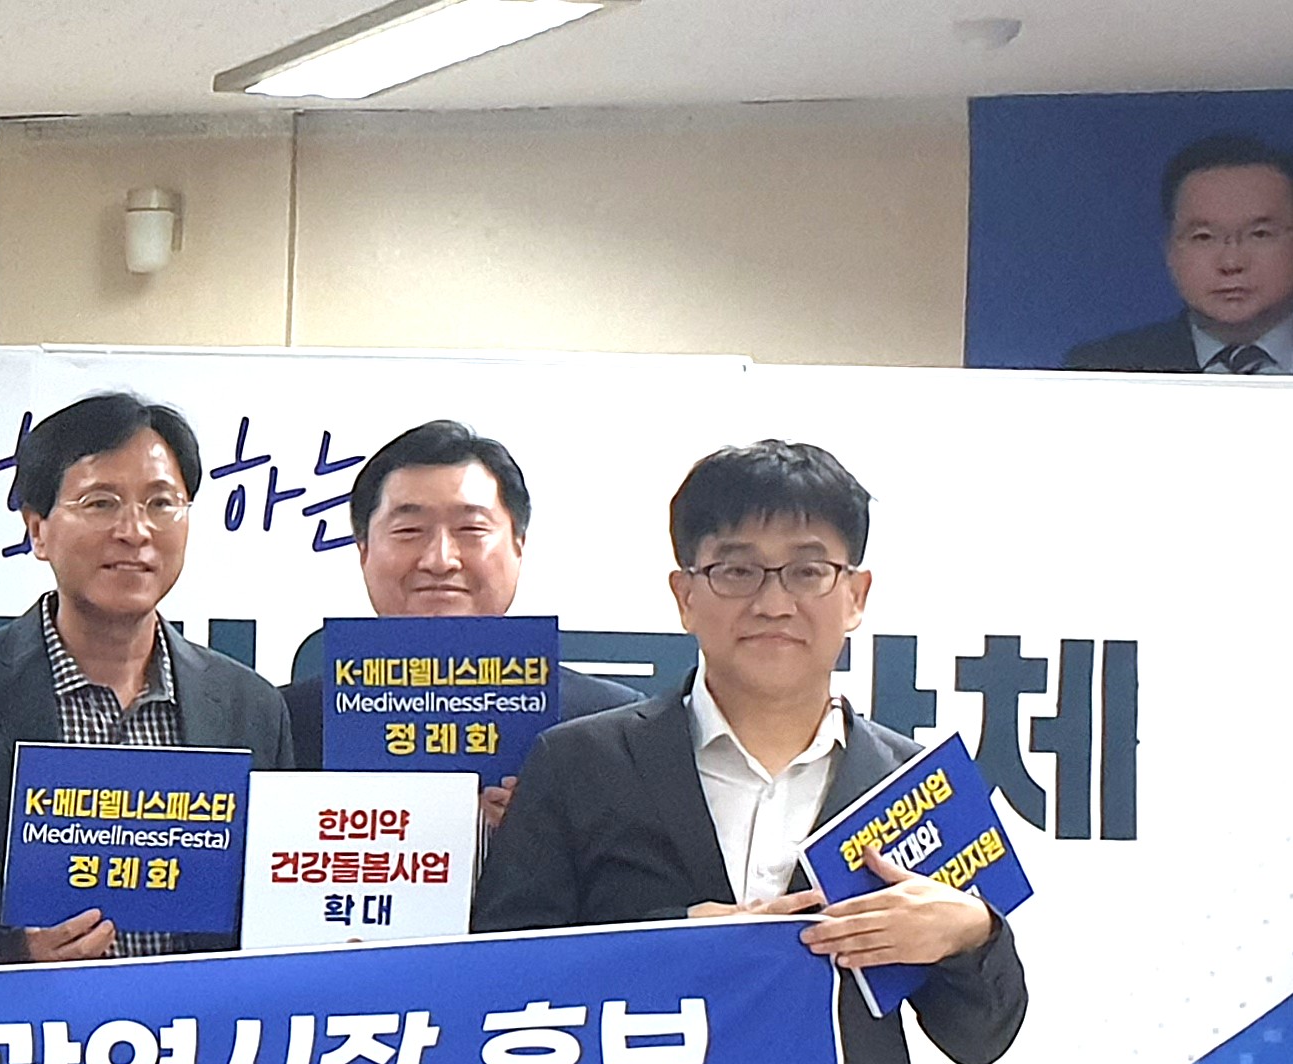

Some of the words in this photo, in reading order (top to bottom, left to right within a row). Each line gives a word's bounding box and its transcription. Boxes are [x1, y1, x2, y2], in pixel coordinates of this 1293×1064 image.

[336, 657, 548, 687] K-메디웰니스페스타
[336, 691, 546, 713] (MediwellnessFesta)
[25, 788, 236, 822] K-메디웰니스페스타
[22, 822, 230, 850] (MediwellnessFesta)
[318, 808, 411, 842] 한의약
[270, 851, 450, 884] 건강돌봄사업
